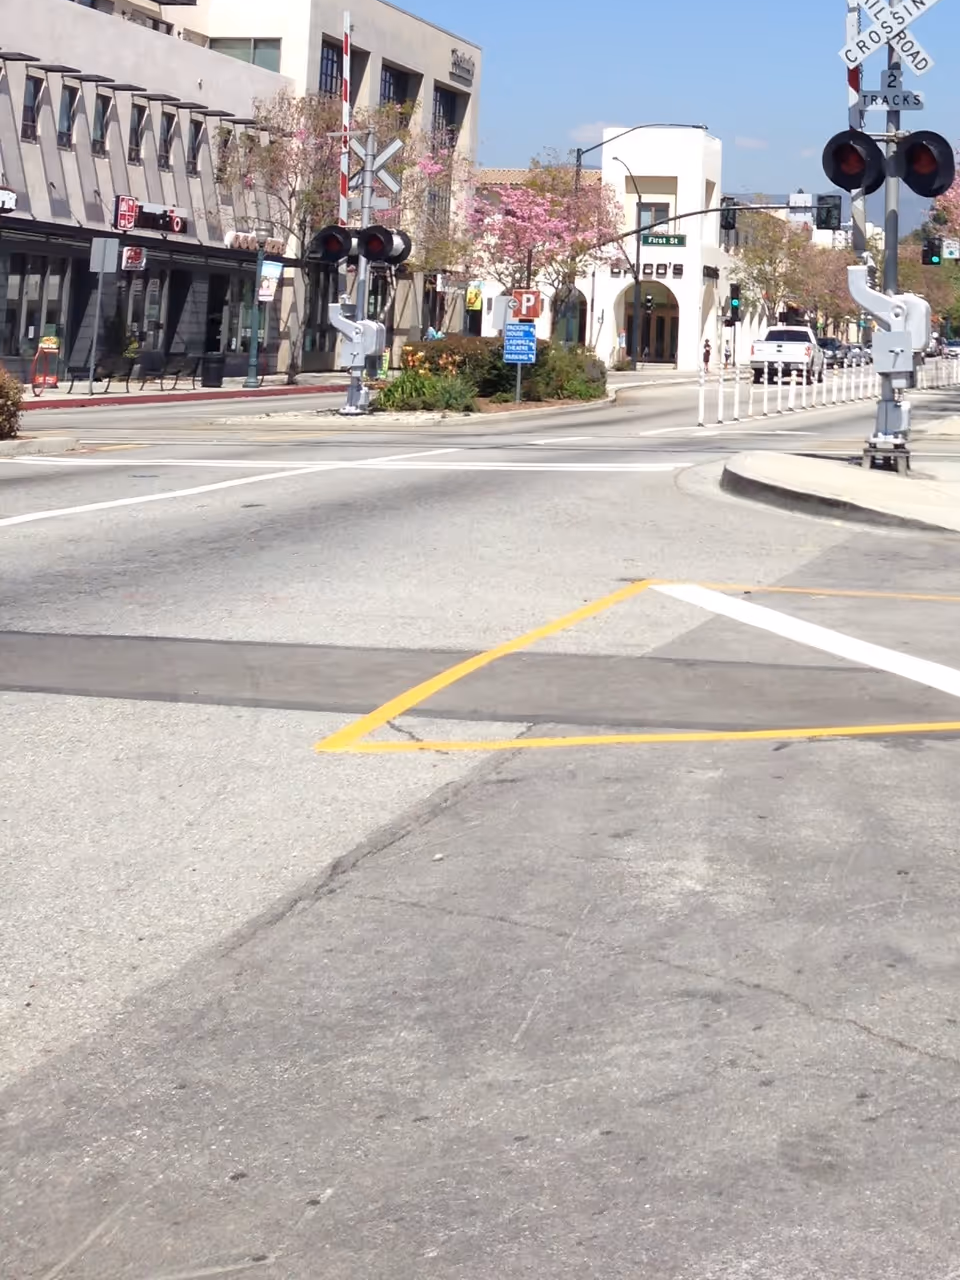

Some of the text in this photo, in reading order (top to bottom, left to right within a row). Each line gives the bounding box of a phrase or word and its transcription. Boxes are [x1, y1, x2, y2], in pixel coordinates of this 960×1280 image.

[887, 74, 898, 88] 2
[862, 94, 922, 106] TRACKS
[648, 236, 667, 244] First
[521, 293, 535, 314] P
